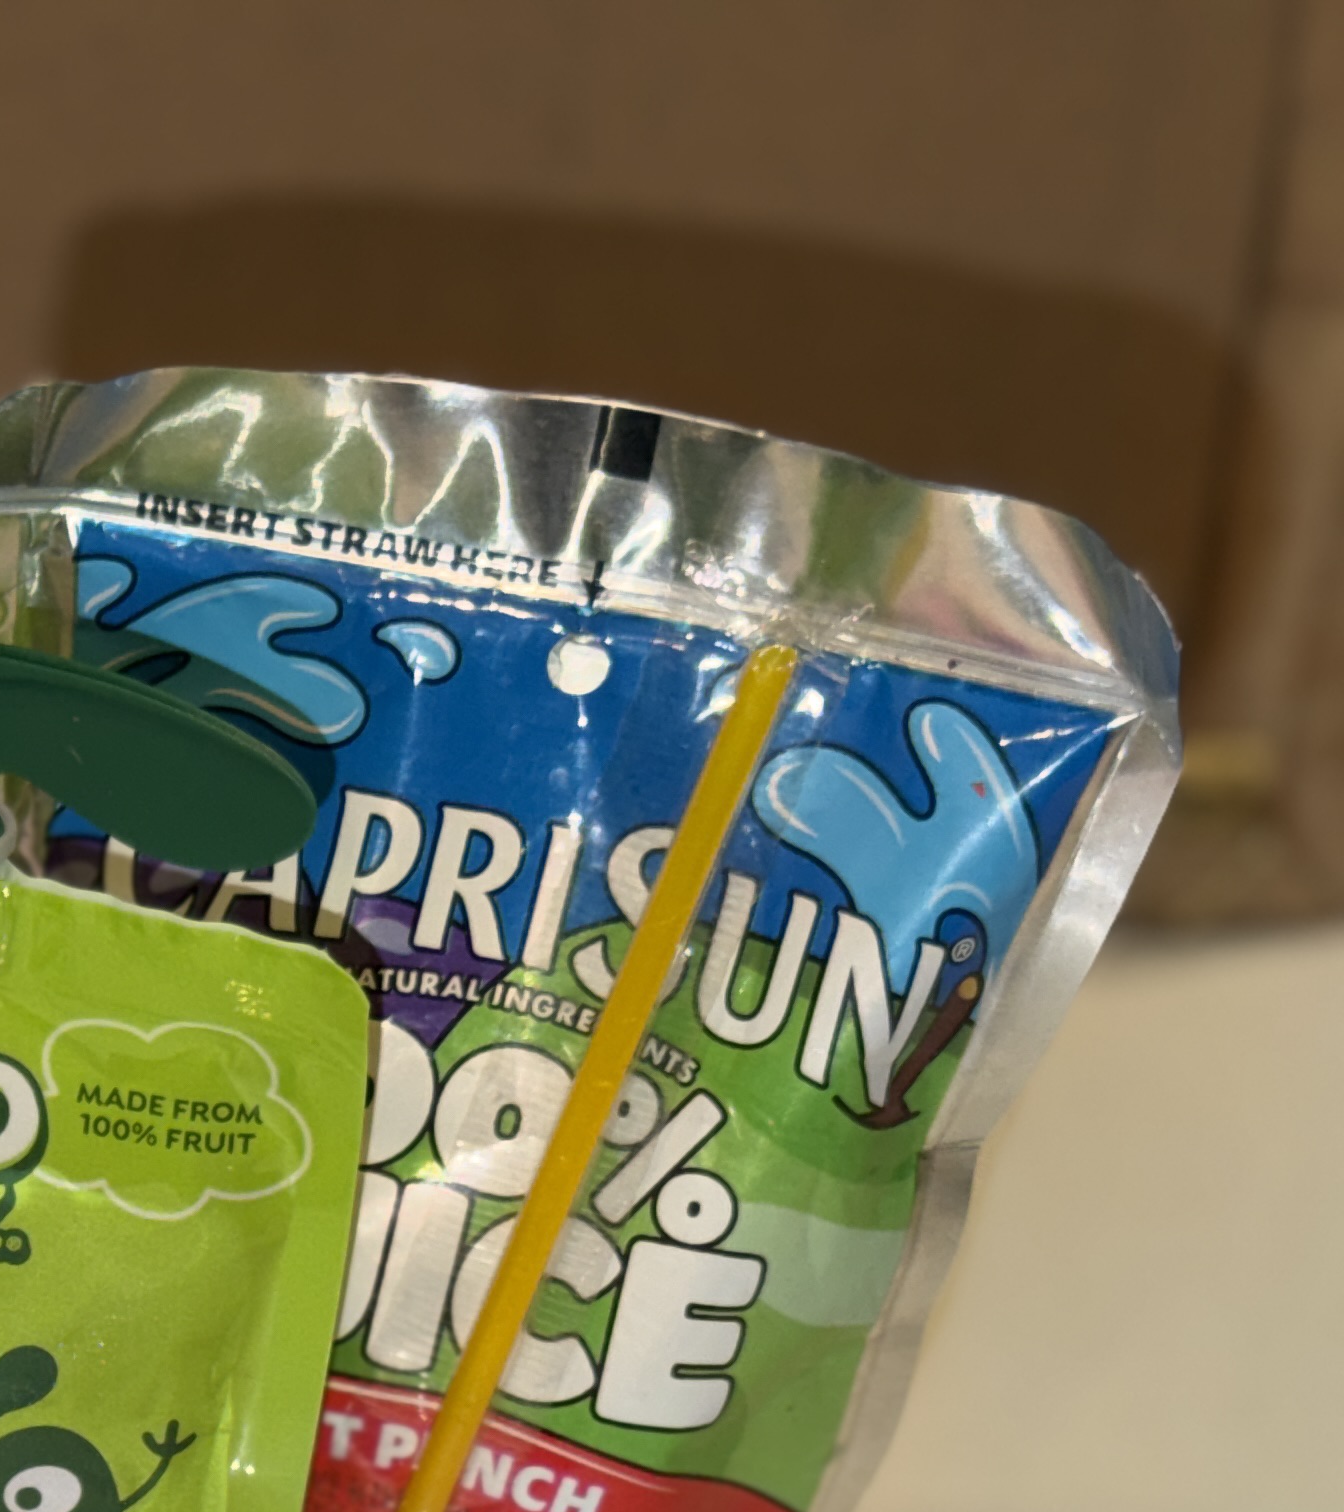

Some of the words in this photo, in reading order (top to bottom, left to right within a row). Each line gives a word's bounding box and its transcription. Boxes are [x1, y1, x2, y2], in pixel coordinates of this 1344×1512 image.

[136, 492, 283, 541] INSERT
[291, 517, 440, 566] STRAW
[450, 543, 562, 588] HERE
[491, 985, 700, 1087] INGRENTS
[76, 1082, 164, 1116] MADE
[172, 1098, 263, 1126] FROM
[80, 1112, 157, 1148] 100%
[164, 1128, 256, 1156] FRUIT
